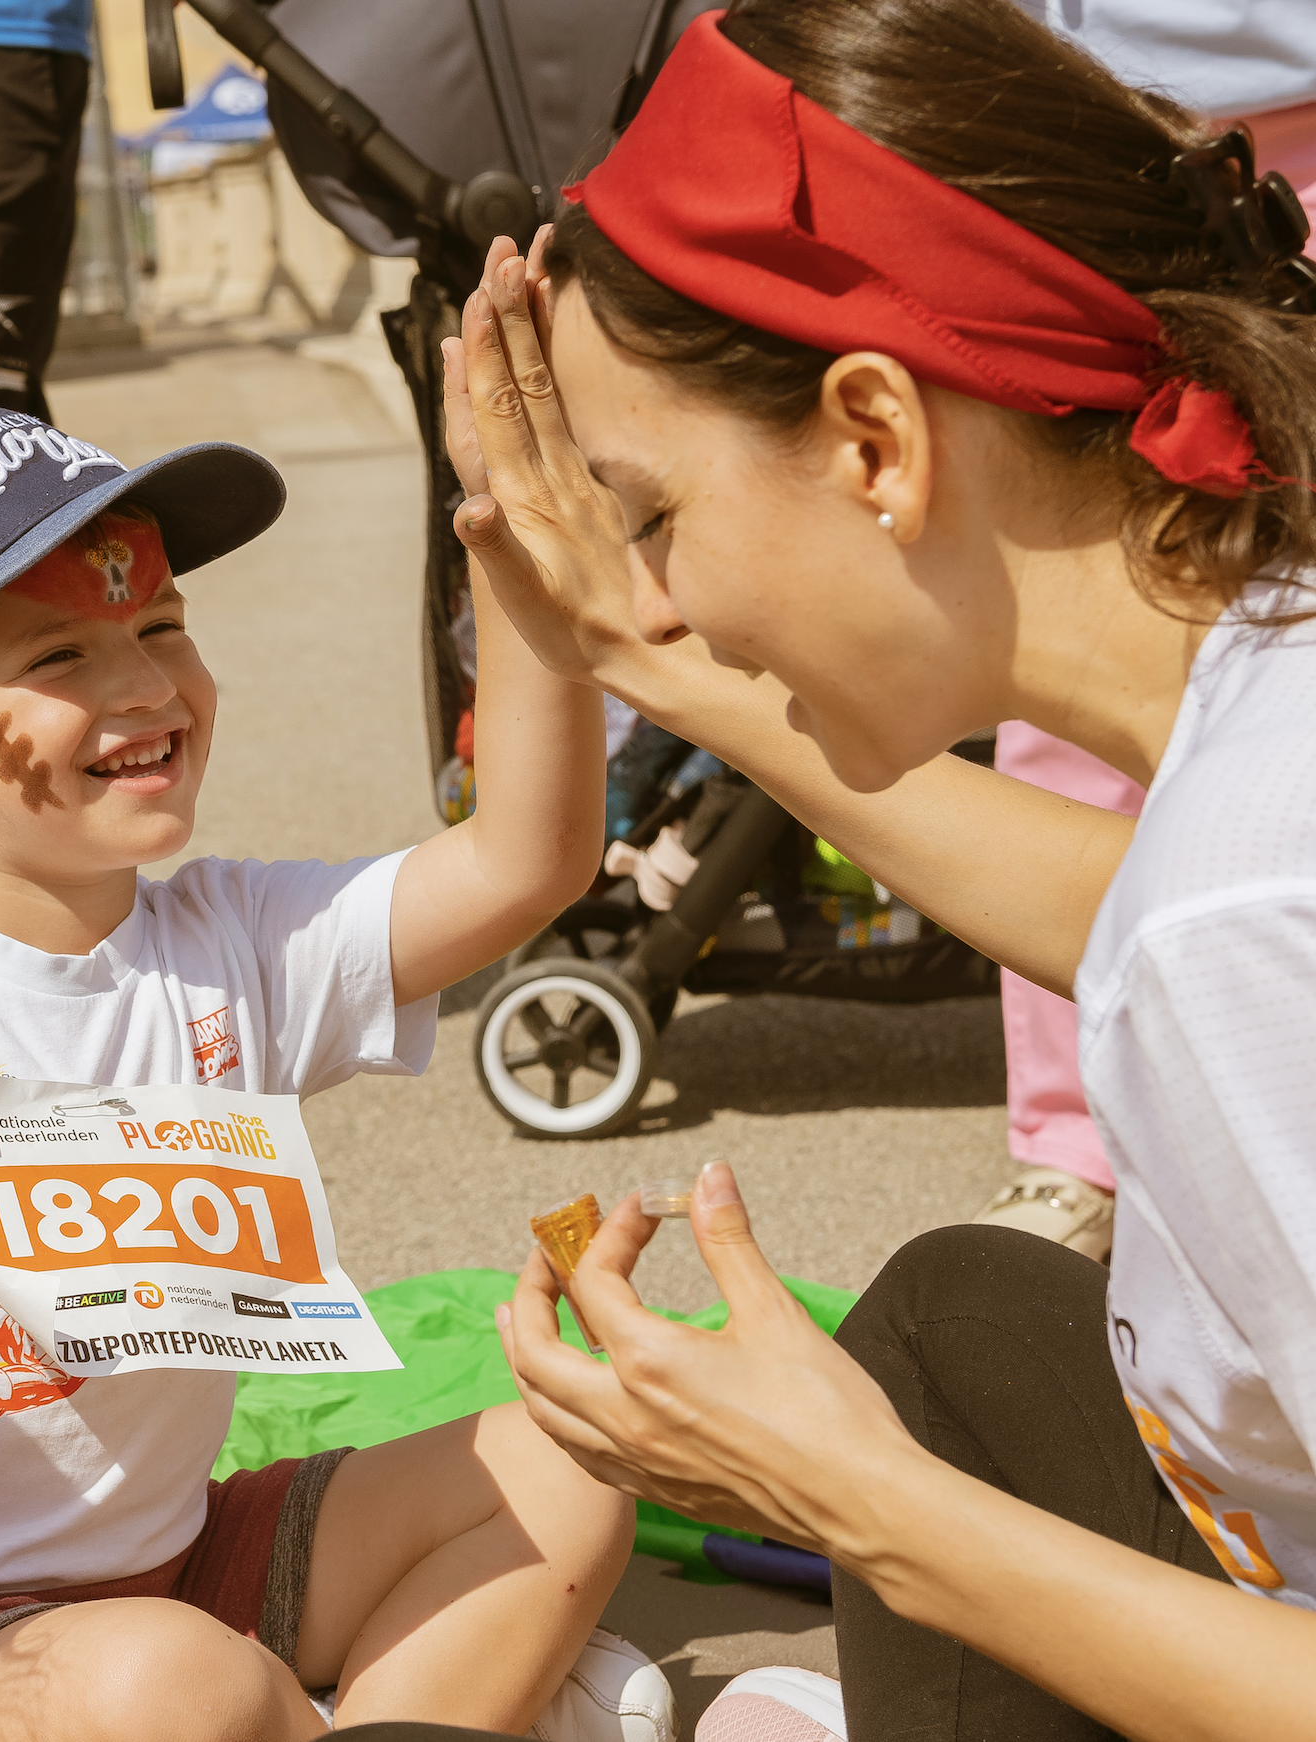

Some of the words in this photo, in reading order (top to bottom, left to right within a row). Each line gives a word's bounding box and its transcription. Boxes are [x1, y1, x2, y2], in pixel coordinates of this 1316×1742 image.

[228, 1112, 266, 1129] TOUR
[166, 1284, 213, 1298] nationale
[55, 1290, 125, 1310] #BEACTIVE
[170, 1294, 229, 1312] nederlanden
[238, 1300, 284, 1314] GARMIN
[297, 1305, 357, 1316] DECATHLON
[55, 1331, 349, 1363] ZDEPORTEPORELPLANETA
